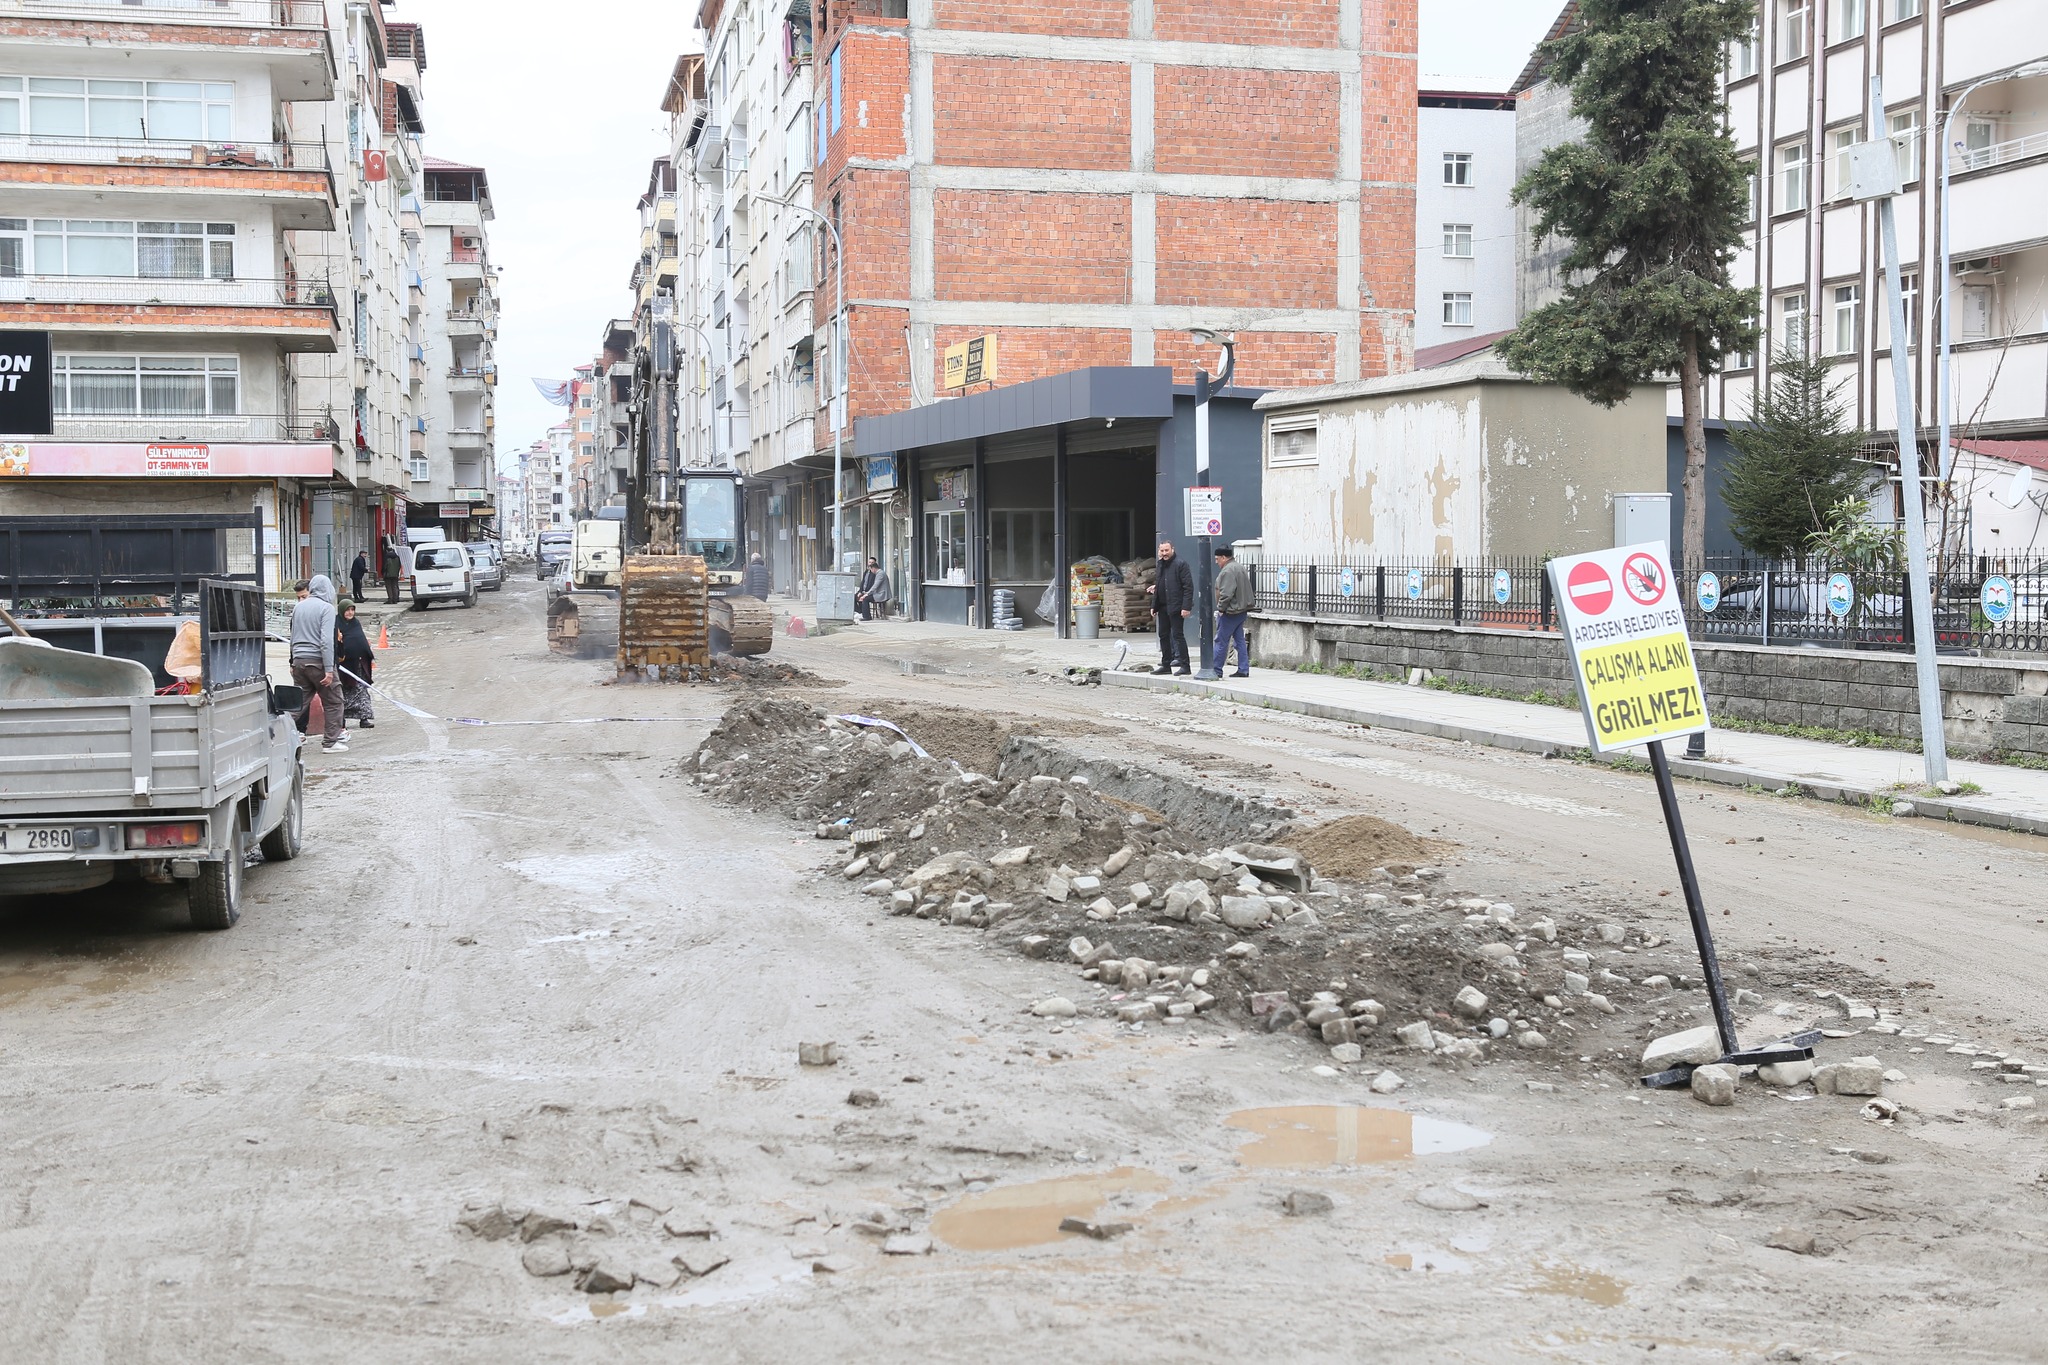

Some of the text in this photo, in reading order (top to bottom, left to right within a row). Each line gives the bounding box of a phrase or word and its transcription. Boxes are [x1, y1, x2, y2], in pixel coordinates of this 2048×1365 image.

[148, 446, 207, 458] SÜLEYMANOĞLU
[1575, 609, 1682, 642] ARDEŞEN BELEDİYESİ
[1585, 642, 1690, 690] ÇALIŞMA ALANI
[1597, 686, 1701, 734] GİRİLMEZ!
[27, 829, 71, 849] 2880
